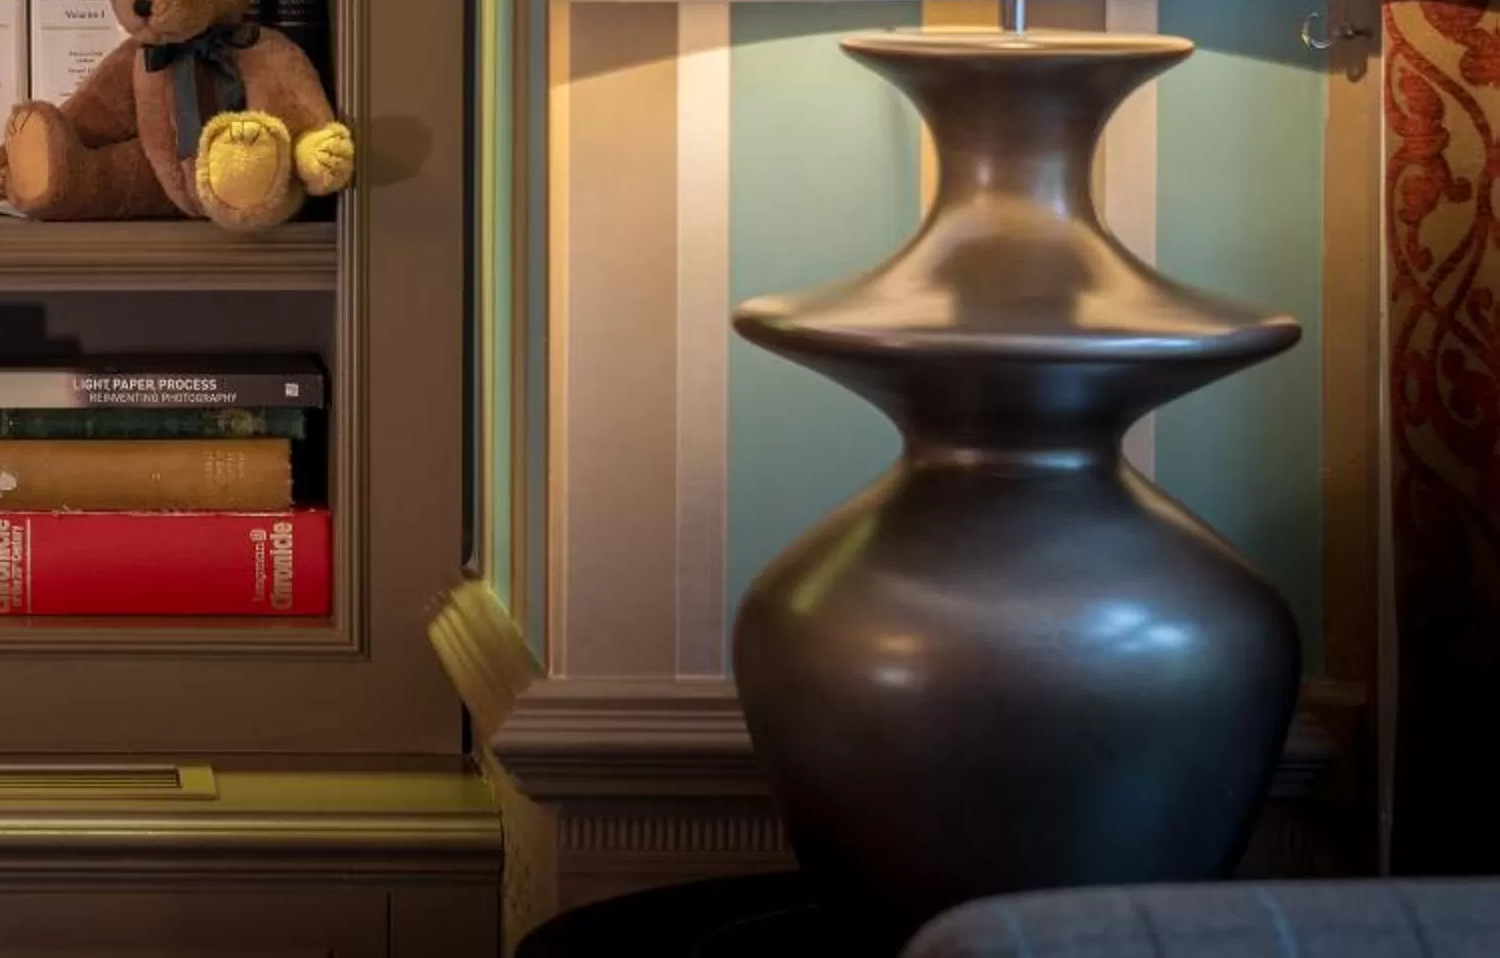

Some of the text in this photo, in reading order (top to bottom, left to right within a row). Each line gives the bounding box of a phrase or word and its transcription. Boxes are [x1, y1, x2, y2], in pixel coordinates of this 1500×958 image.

[73, 378, 218, 392] LIGHT PAPER PROCESS
[161, 392, 238, 403] PHOTOGRAPHY
